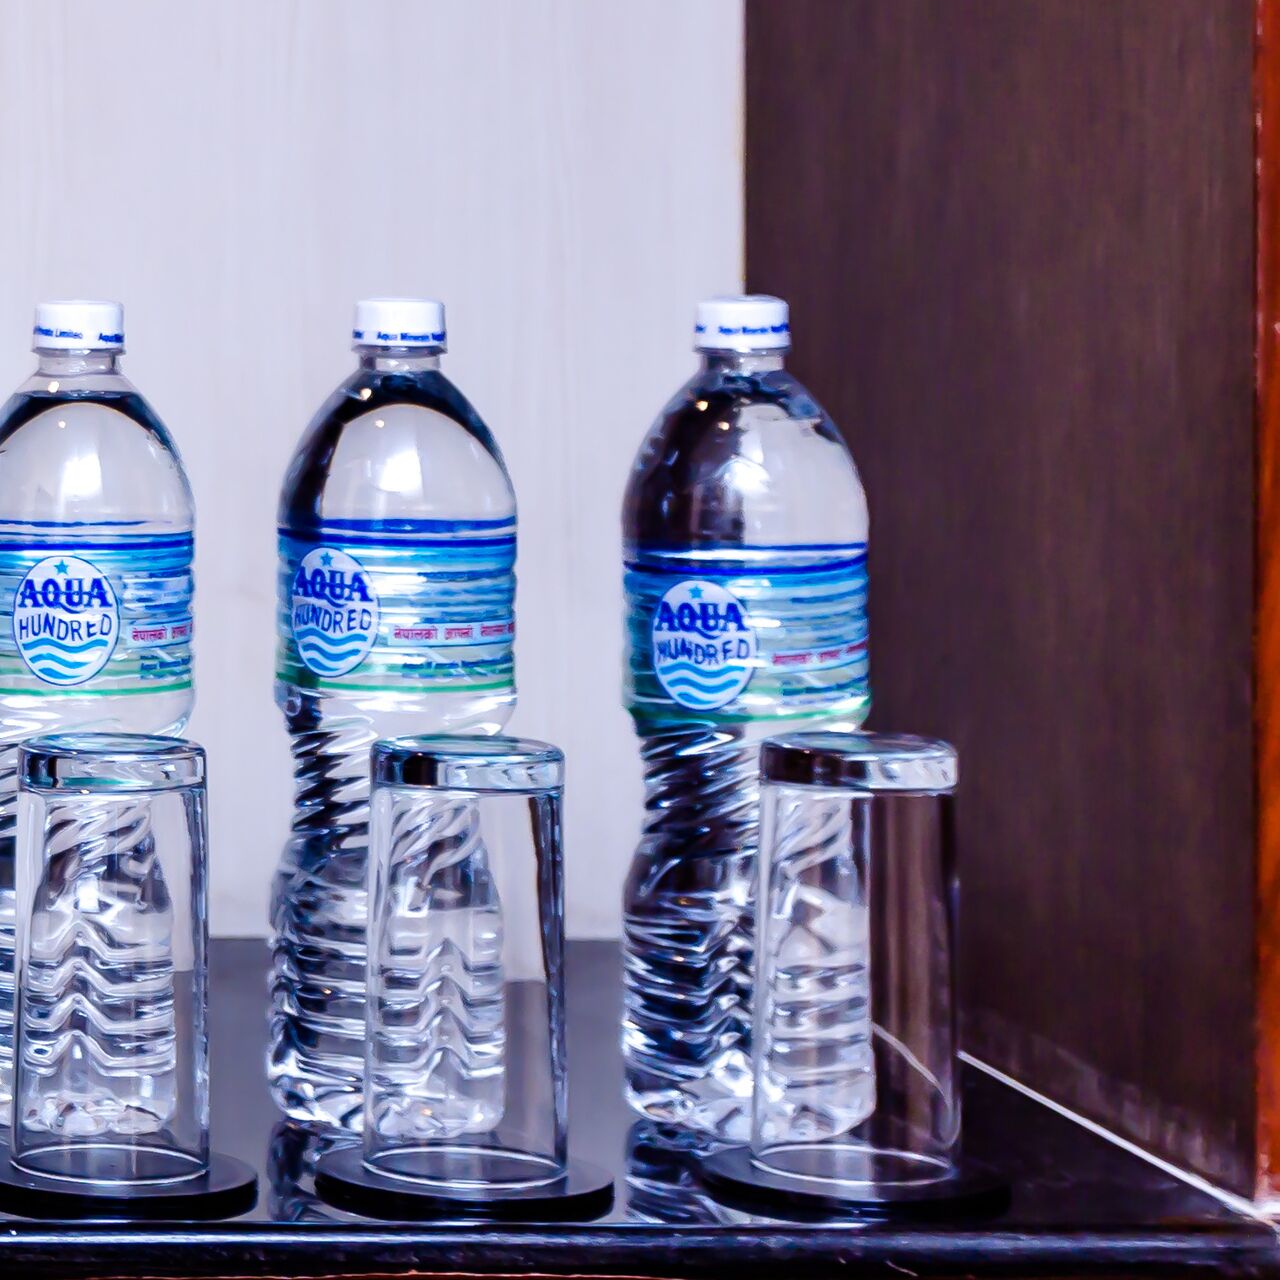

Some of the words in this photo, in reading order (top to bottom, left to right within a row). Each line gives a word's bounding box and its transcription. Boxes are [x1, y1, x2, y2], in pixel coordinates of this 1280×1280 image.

[18, 577, 113, 614] AQUA
[292, 566, 374, 608] AQUA
[19, 612, 112, 642] HUNDRED
[294, 604, 372, 634] HUNDRED
[654, 601, 750, 640] AQUA
